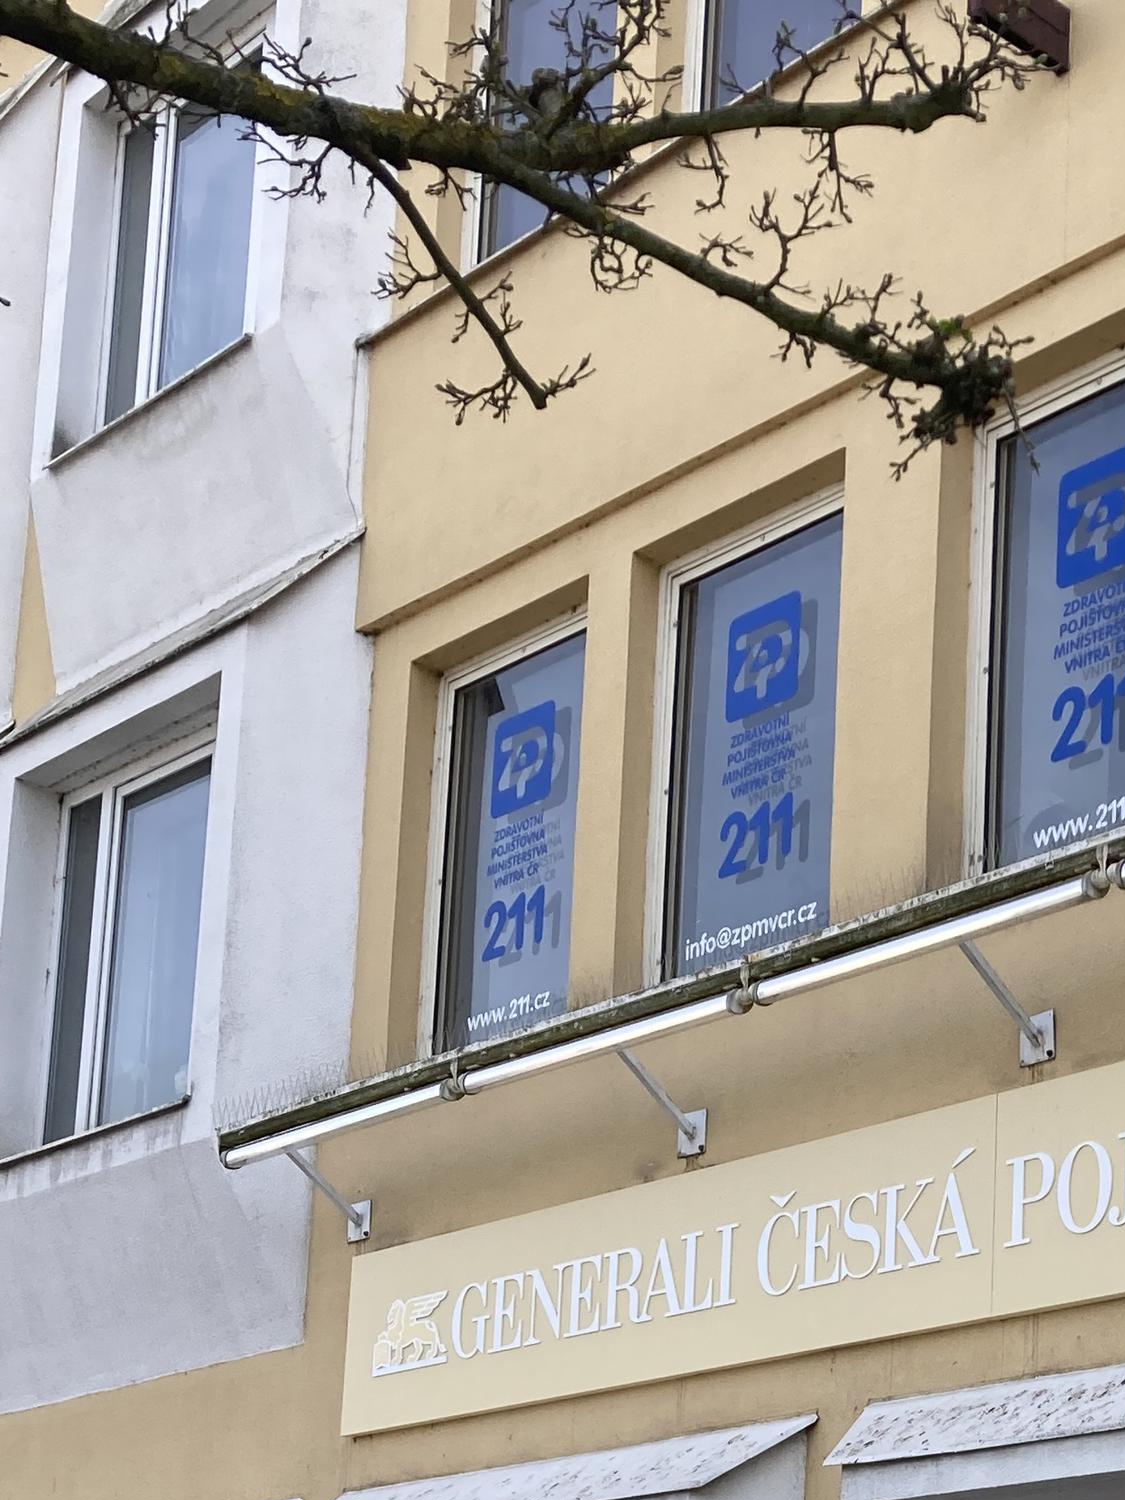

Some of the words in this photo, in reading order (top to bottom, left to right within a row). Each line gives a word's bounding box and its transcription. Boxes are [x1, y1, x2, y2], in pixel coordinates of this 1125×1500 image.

[718, 792, 794, 880] 211
[481, 884, 545, 963] 211
[685, 901, 817, 961] info@zpmvcr.cz
[467, 991, 550, 1032] www.211.cz
[451, 1223, 739, 1359] GENERALI
[757, 1147, 981, 1296] ČESKÁ
